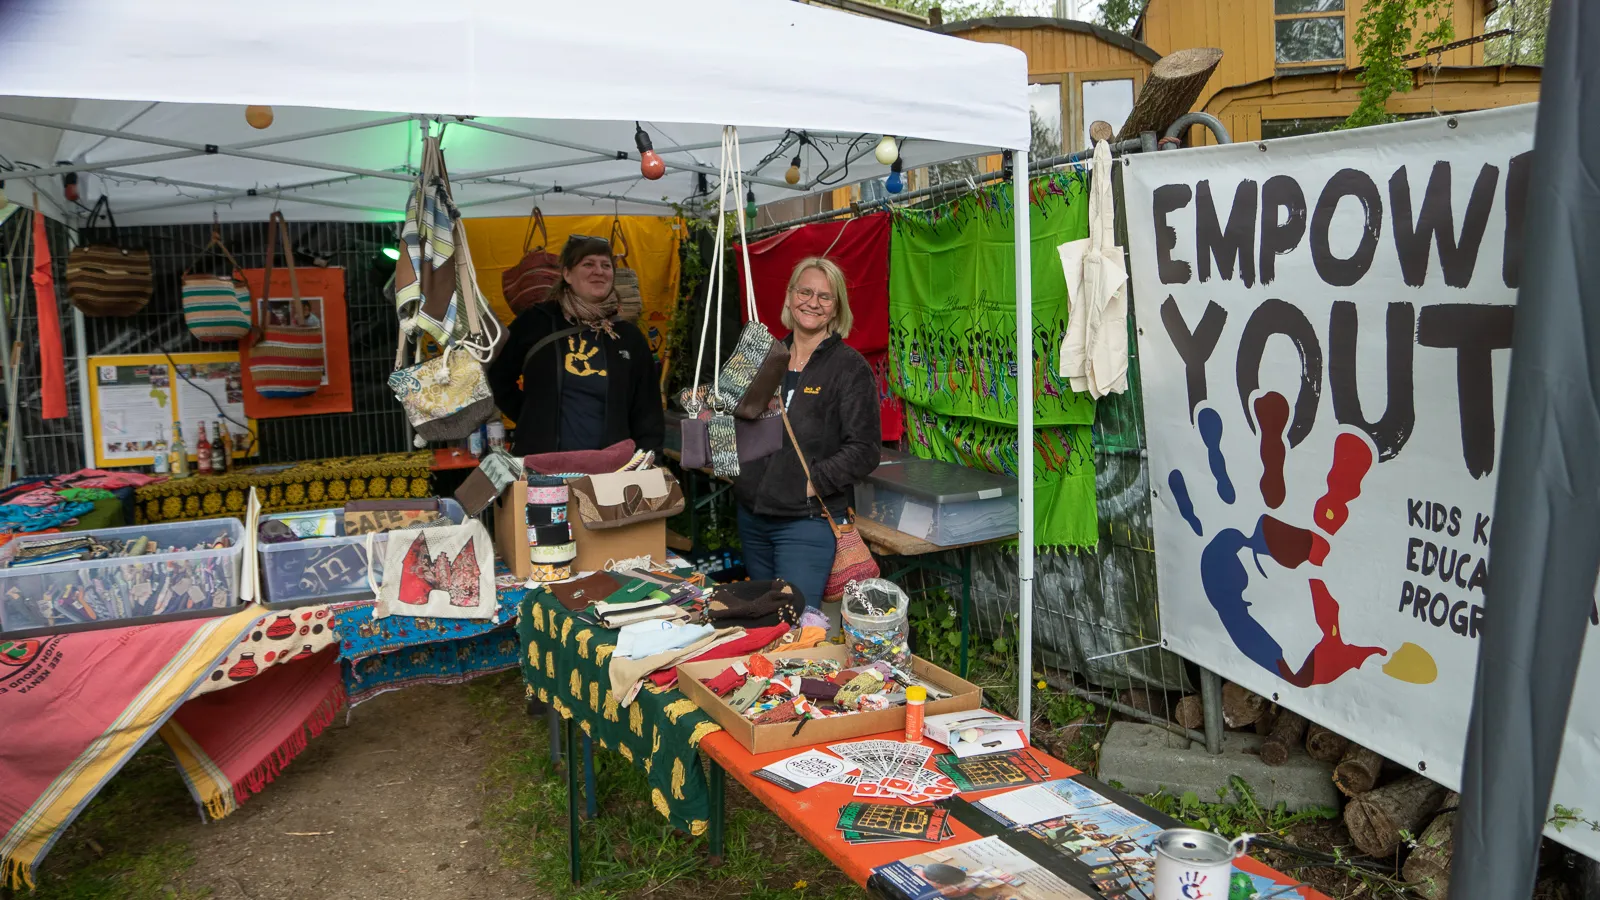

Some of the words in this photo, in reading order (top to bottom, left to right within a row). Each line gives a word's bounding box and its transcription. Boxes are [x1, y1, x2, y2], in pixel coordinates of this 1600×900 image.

[1407, 498, 1462, 537] KIDS
[1406, 537, 1488, 596] EDUCA
[1398, 580, 1486, 639] PROGR
[47, 651, 63, 669] SEE
[9, 663, 43, 689] PROUD
[18, 669, 50, 694] KENYA
[810, 757, 838, 769] OMAS
